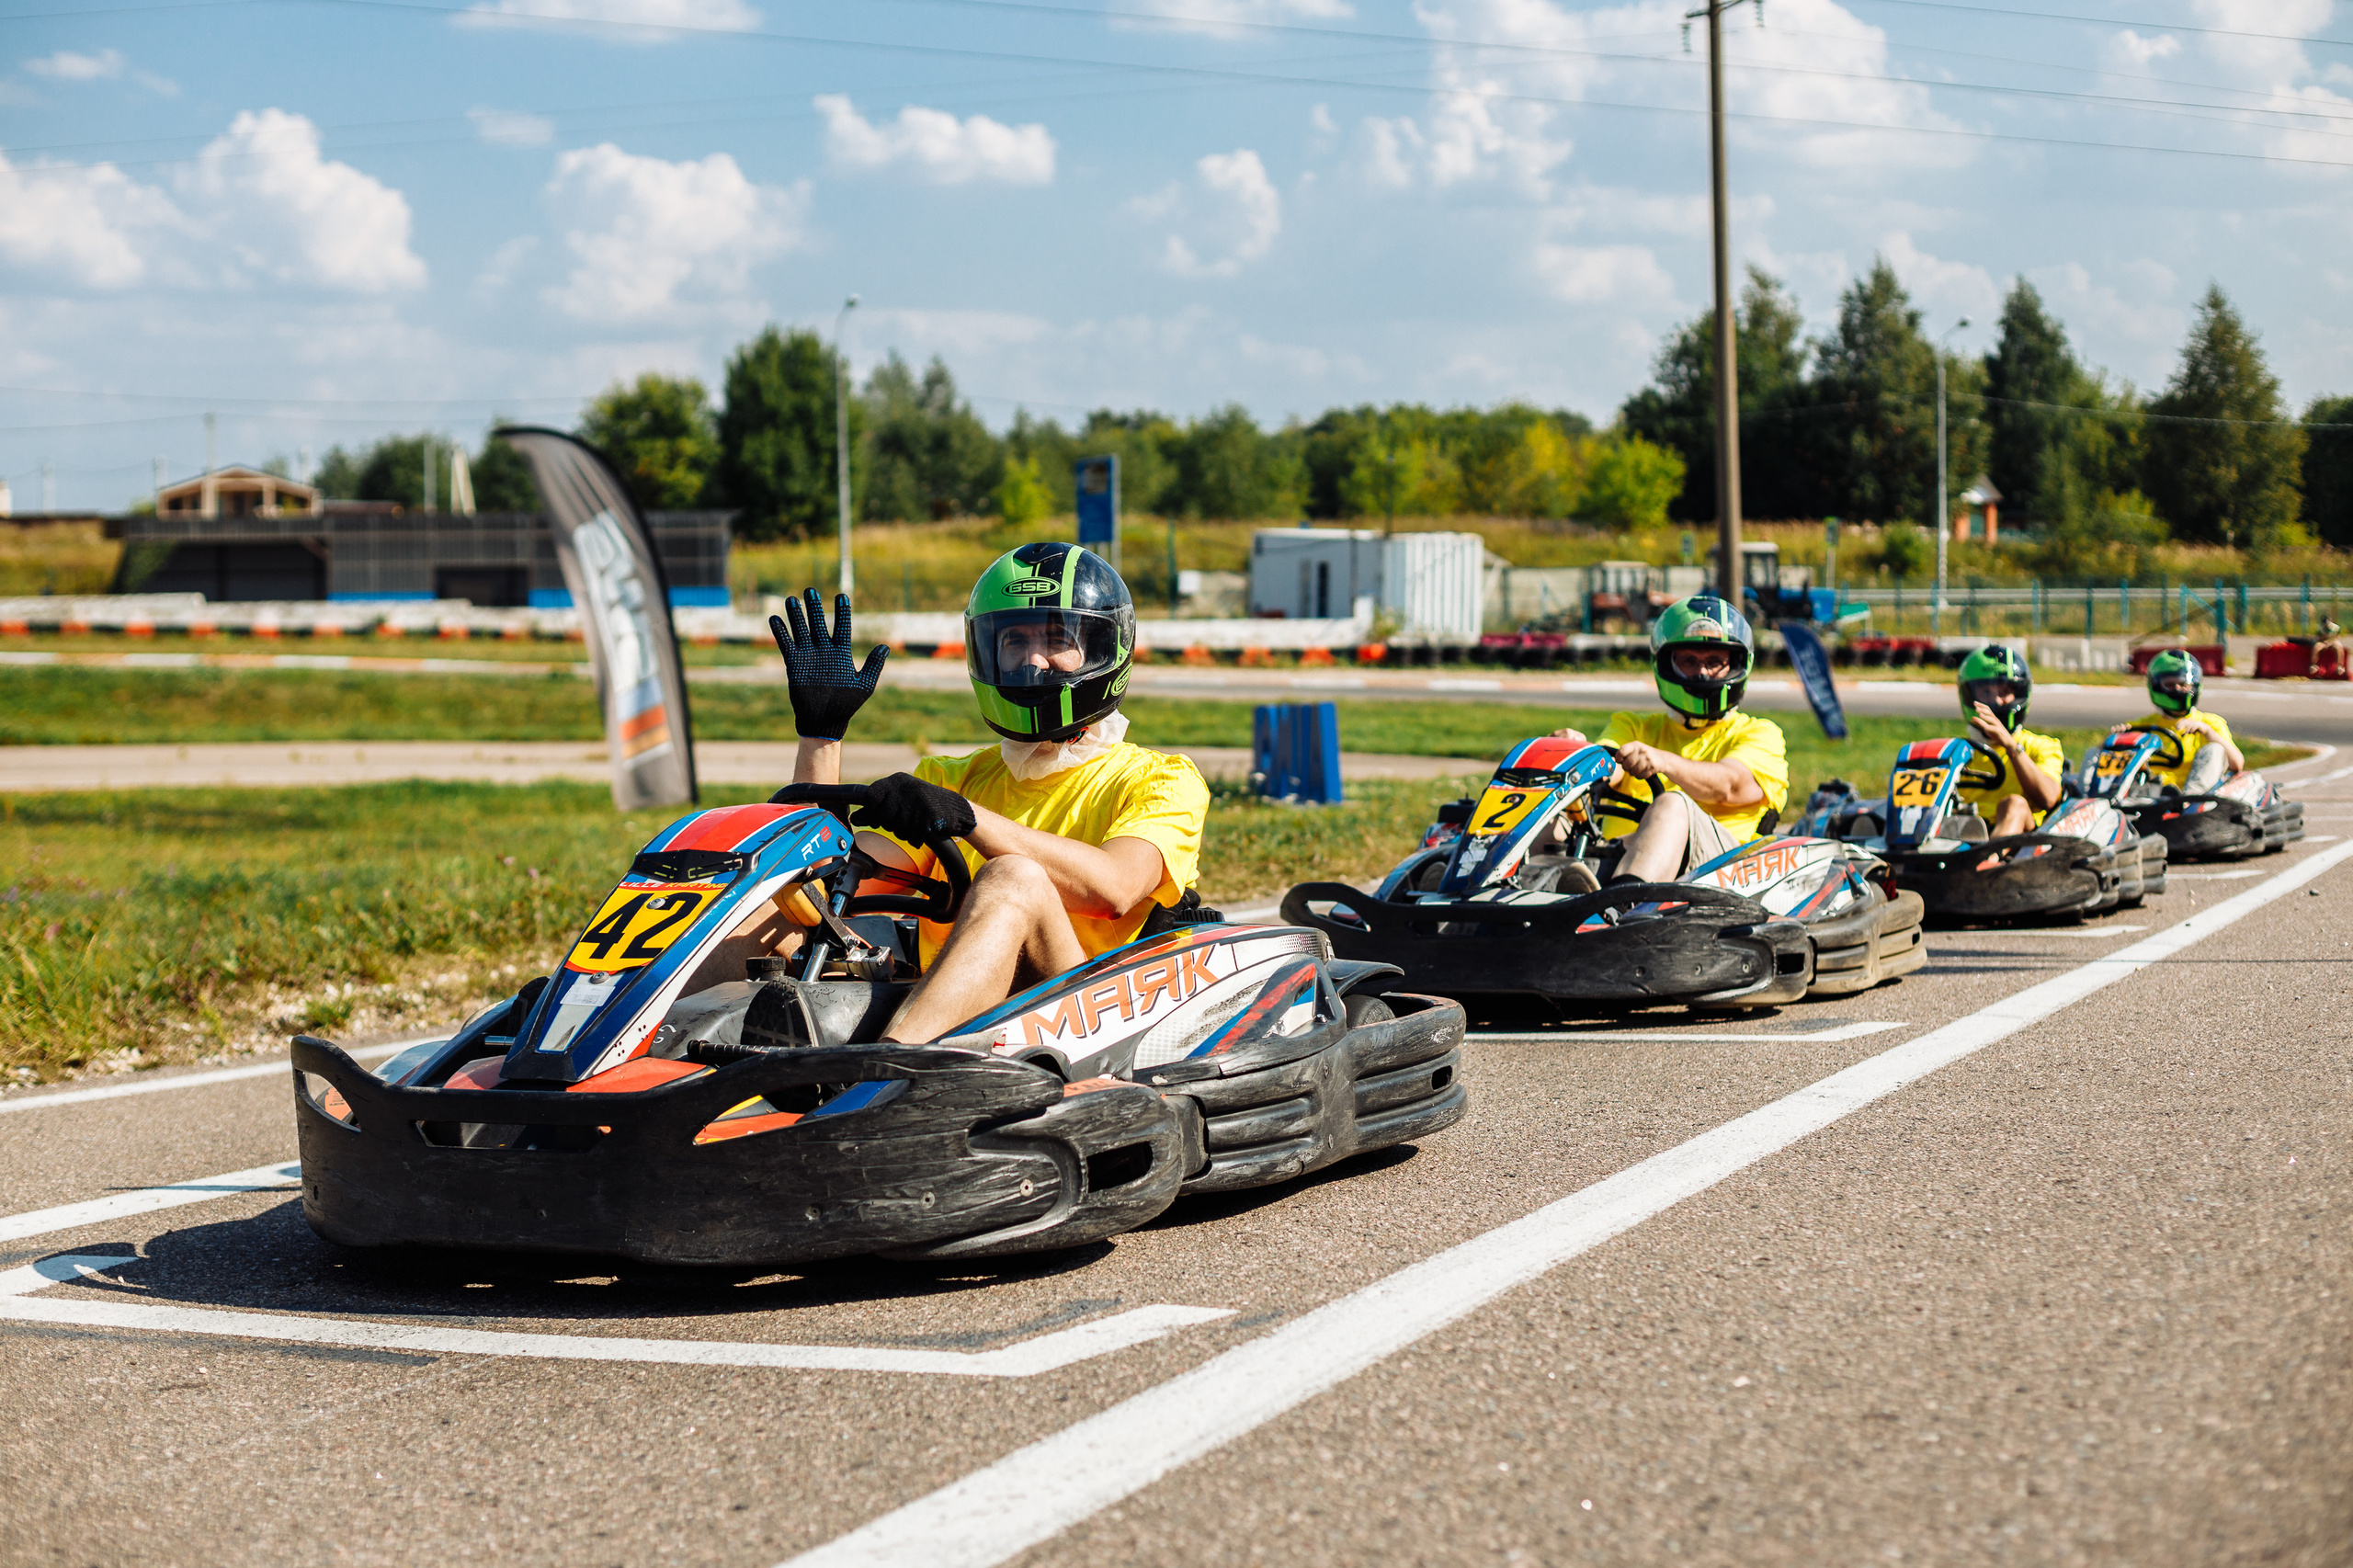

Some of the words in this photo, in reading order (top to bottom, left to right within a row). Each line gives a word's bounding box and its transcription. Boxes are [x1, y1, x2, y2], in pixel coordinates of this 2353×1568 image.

[1008, 582, 1051, 594] GSB
[1895, 772, 1941, 796] 26
[1481, 792, 1527, 828] 2
[801, 825, 832, 861] RT8
[1715, 845, 1801, 889] МАЯК
[579, 892, 703, 960] 42
[1020, 943, 1221, 1046] МАЯК
